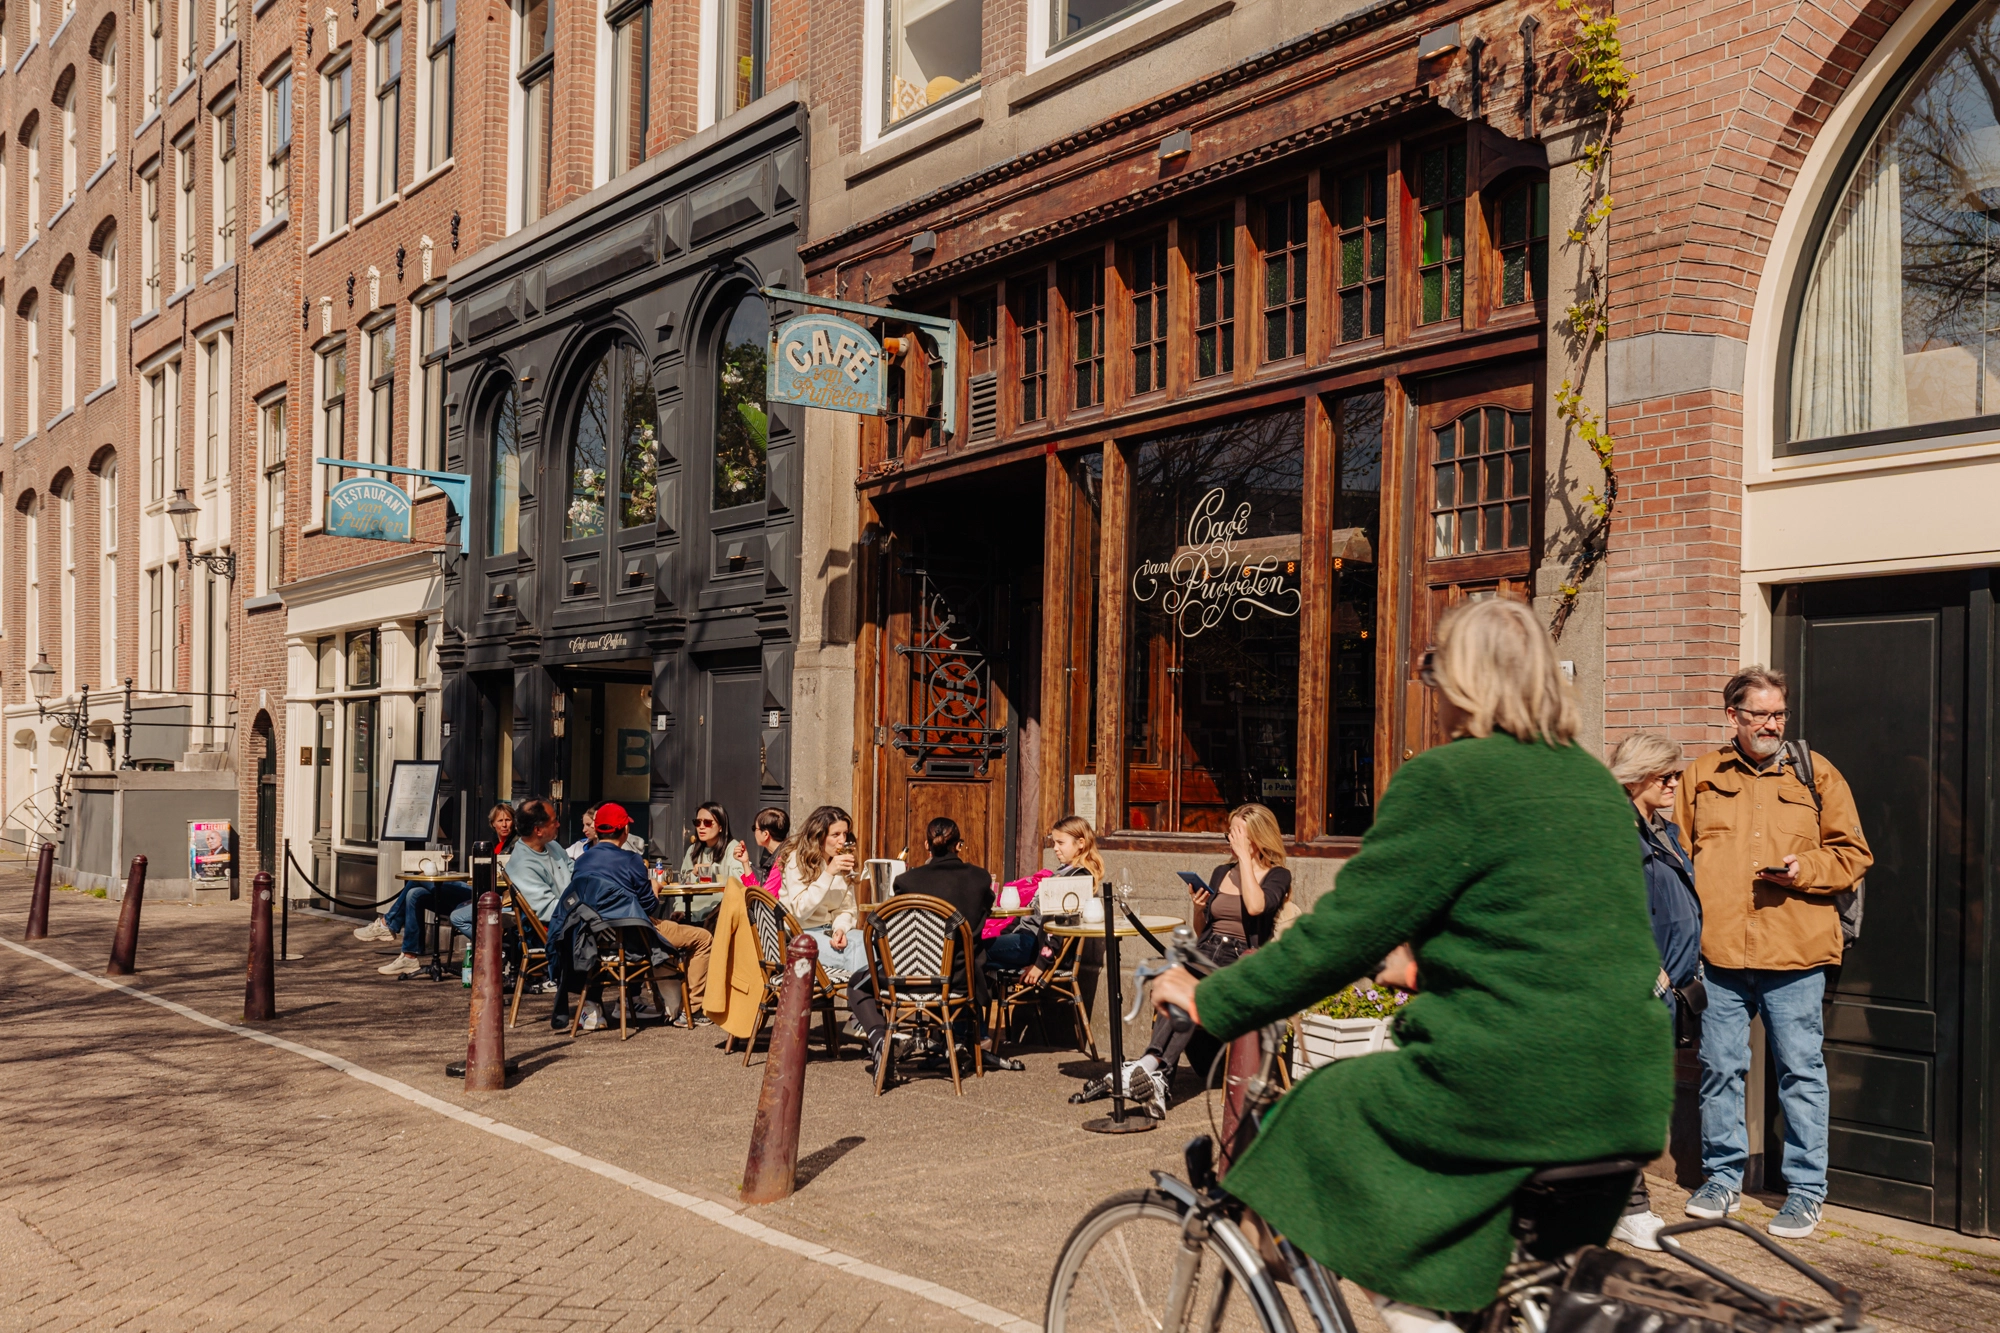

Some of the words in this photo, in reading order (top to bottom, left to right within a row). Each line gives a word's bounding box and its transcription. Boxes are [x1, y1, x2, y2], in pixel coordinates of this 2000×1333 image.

[785, 329, 875, 384] CAFE
[812, 367, 843, 384] van
[787, 376, 870, 410] Puffelen
[335, 486, 408, 515] RESTAURANT
[357, 501, 383, 513] van
[336, 512, 404, 533] Puffelen
[1163, 545, 1301, 638] Puffelen
[1263, 782, 1273, 791] Le
